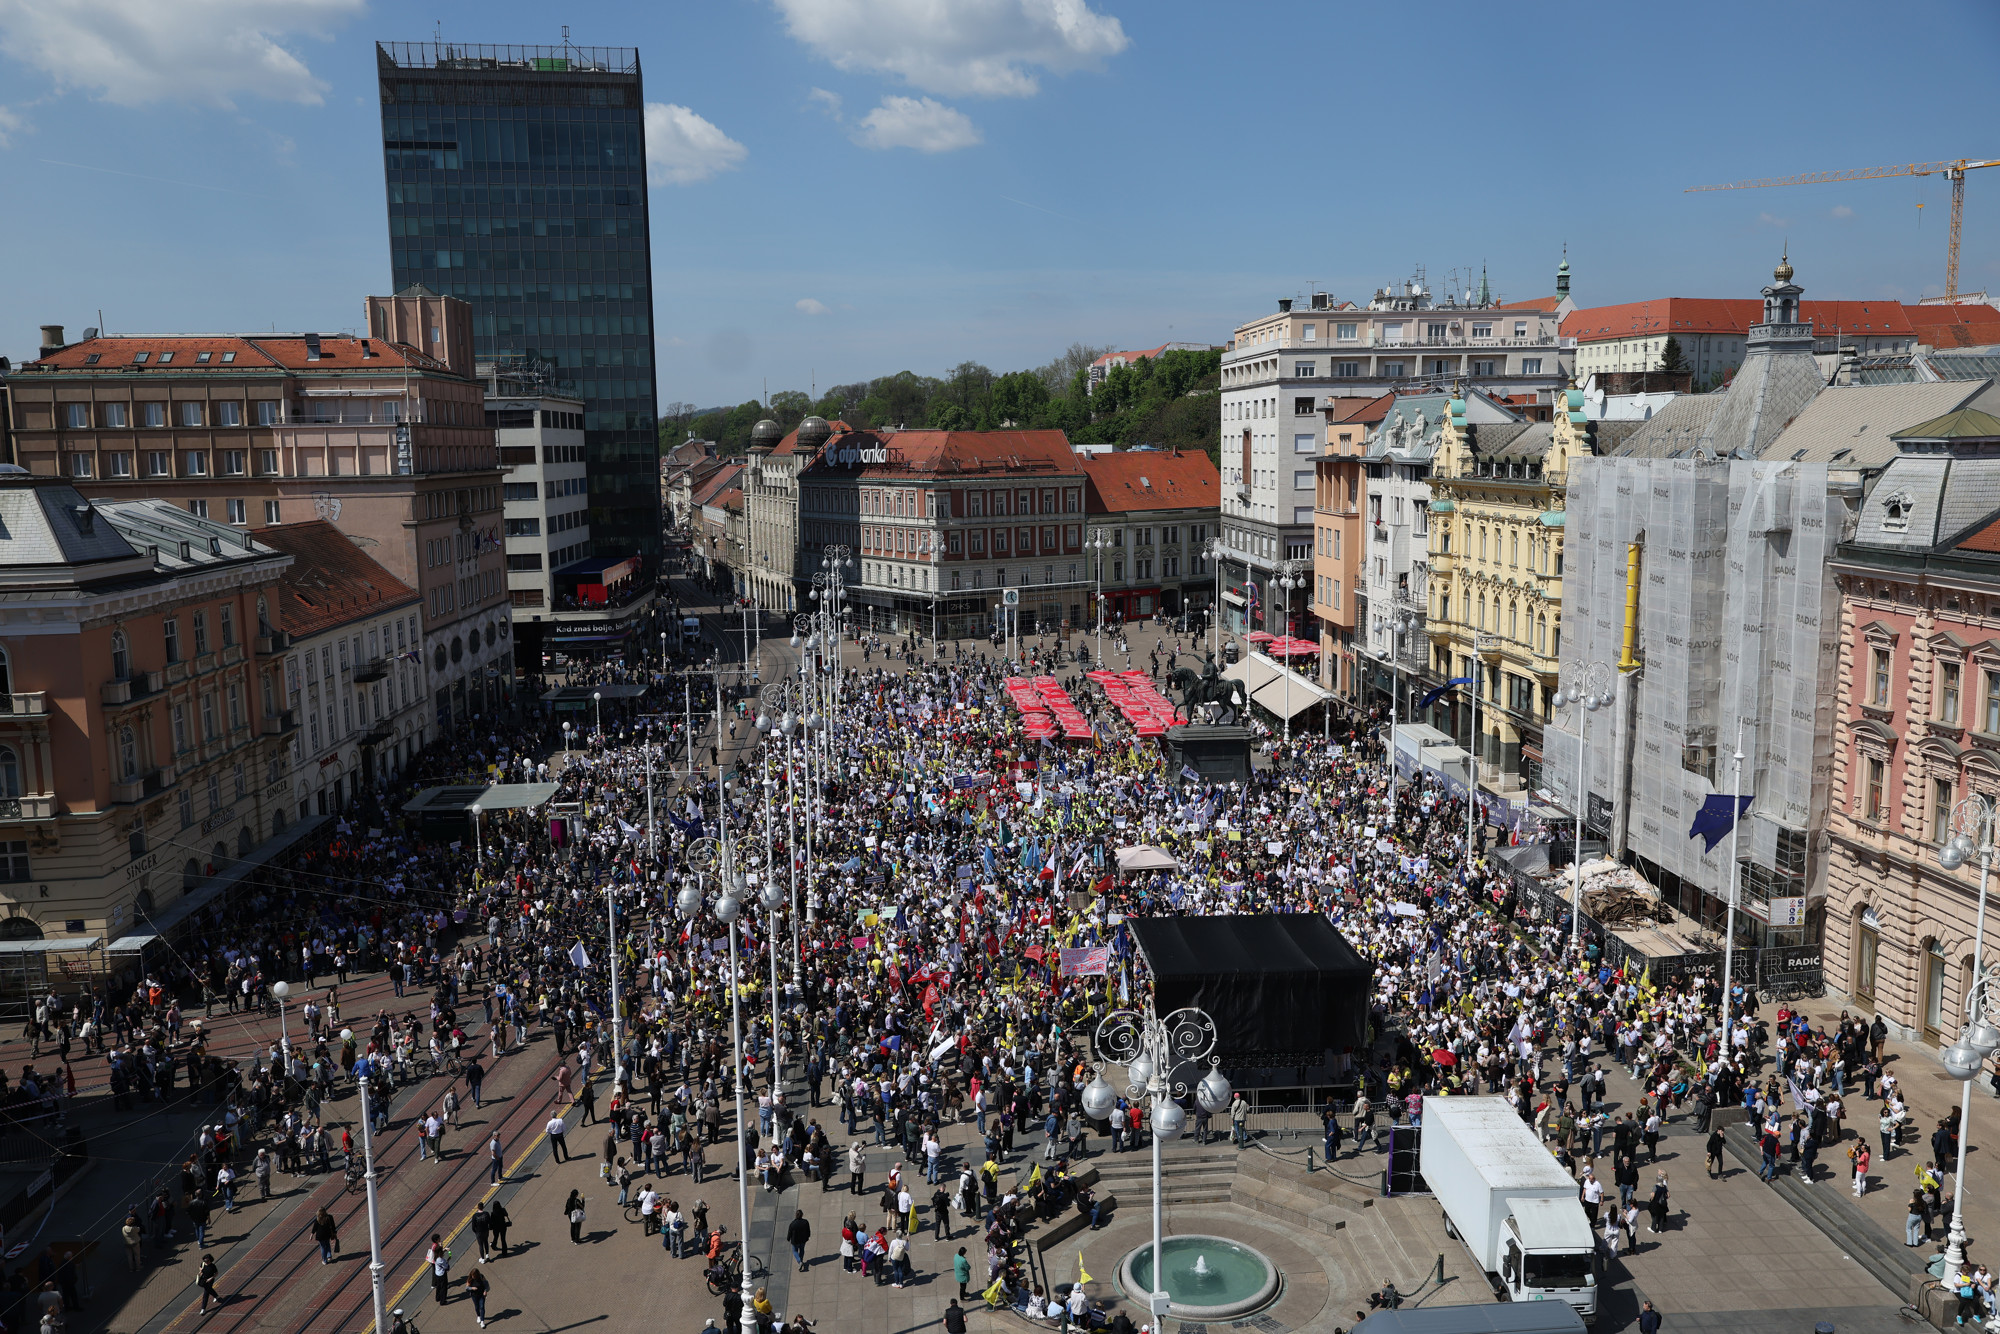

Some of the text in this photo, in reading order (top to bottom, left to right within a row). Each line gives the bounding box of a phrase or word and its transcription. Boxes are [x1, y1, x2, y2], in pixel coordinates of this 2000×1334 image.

[1674, 461, 1692, 472] RADIĆ
[1654, 487, 1668, 498] RADIĆ
[1801, 517, 1822, 528] RADIĆ
[1669, 548, 1685, 559] RADIĆ
[1690, 550, 1722, 562] RADIĆ
[1650, 573, 1664, 585] RADIĆ
[1796, 614, 1817, 626] RADIĆ
[573, 623, 591, 632] znaš
[1743, 623, 1763, 633] RADIĆ
[1666, 635, 1683, 646] RADIĆ
[1647, 658, 1662, 669] RADIĆ
[1791, 709, 1812, 722] RADIĆ
[1664, 720, 1680, 733] RADIĆ
[1645, 741, 1660, 753] RADIĆ
[266, 780, 287, 799] SINGER
[1683, 790, 1700, 805] RADIĆ
[1663, 805, 1679, 819] RADIĆ
[1643, 822, 1658, 835] RADIĆ
[127, 854, 157, 880] SINGER
[1788, 956, 1820, 966] RADIĆ
[1064, 964, 1106, 974] ZADAR
